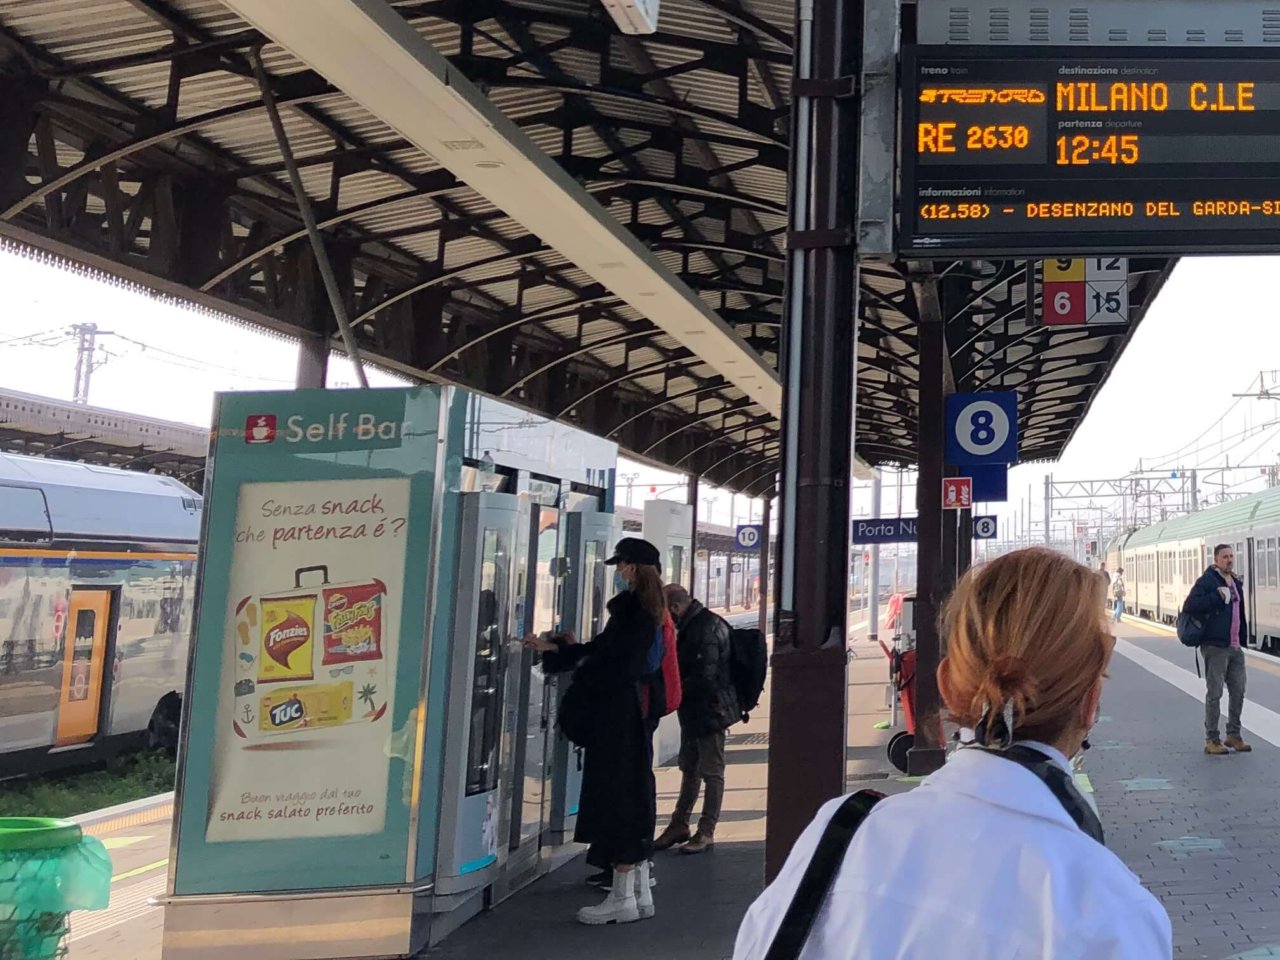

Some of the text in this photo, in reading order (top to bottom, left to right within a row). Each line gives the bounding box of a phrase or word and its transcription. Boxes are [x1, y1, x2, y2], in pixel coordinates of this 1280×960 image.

[920, 65, 949, 75] treno
[1058, 65, 1159, 76] destinazione destination
[1056, 82, 1255, 112] MILANO C.LE
[1058, 118, 1143, 130] partenza departure
[917, 123, 1030, 153] RE 2630
[1056, 134, 1140, 166] 12:45
[919, 186, 1026, 198] informazioni information
[919, 203, 991, 219] (12.58)
[1026, 202, 1134, 218] DESENZANO
[1146, 202, 1181, 217] DEL
[1054, 291, 1122, 315] 6 15
[286, 412, 349, 443] Self
[970, 409, 996, 446] 8
[261, 492, 385, 518] Senza snack
[234, 525, 266, 543] che
[272, 523, 368, 549] partenza
[741, 531, 756, 542] 10
[858, 522, 895, 537] Porta
[981, 521, 990, 533] 8
[269, 624, 308, 647] Fonzies
[272, 702, 301, 724] TUC
[240, 788, 362, 806] Buon viaggio dal tuo
[220, 801, 375, 822] snack salato preferito
